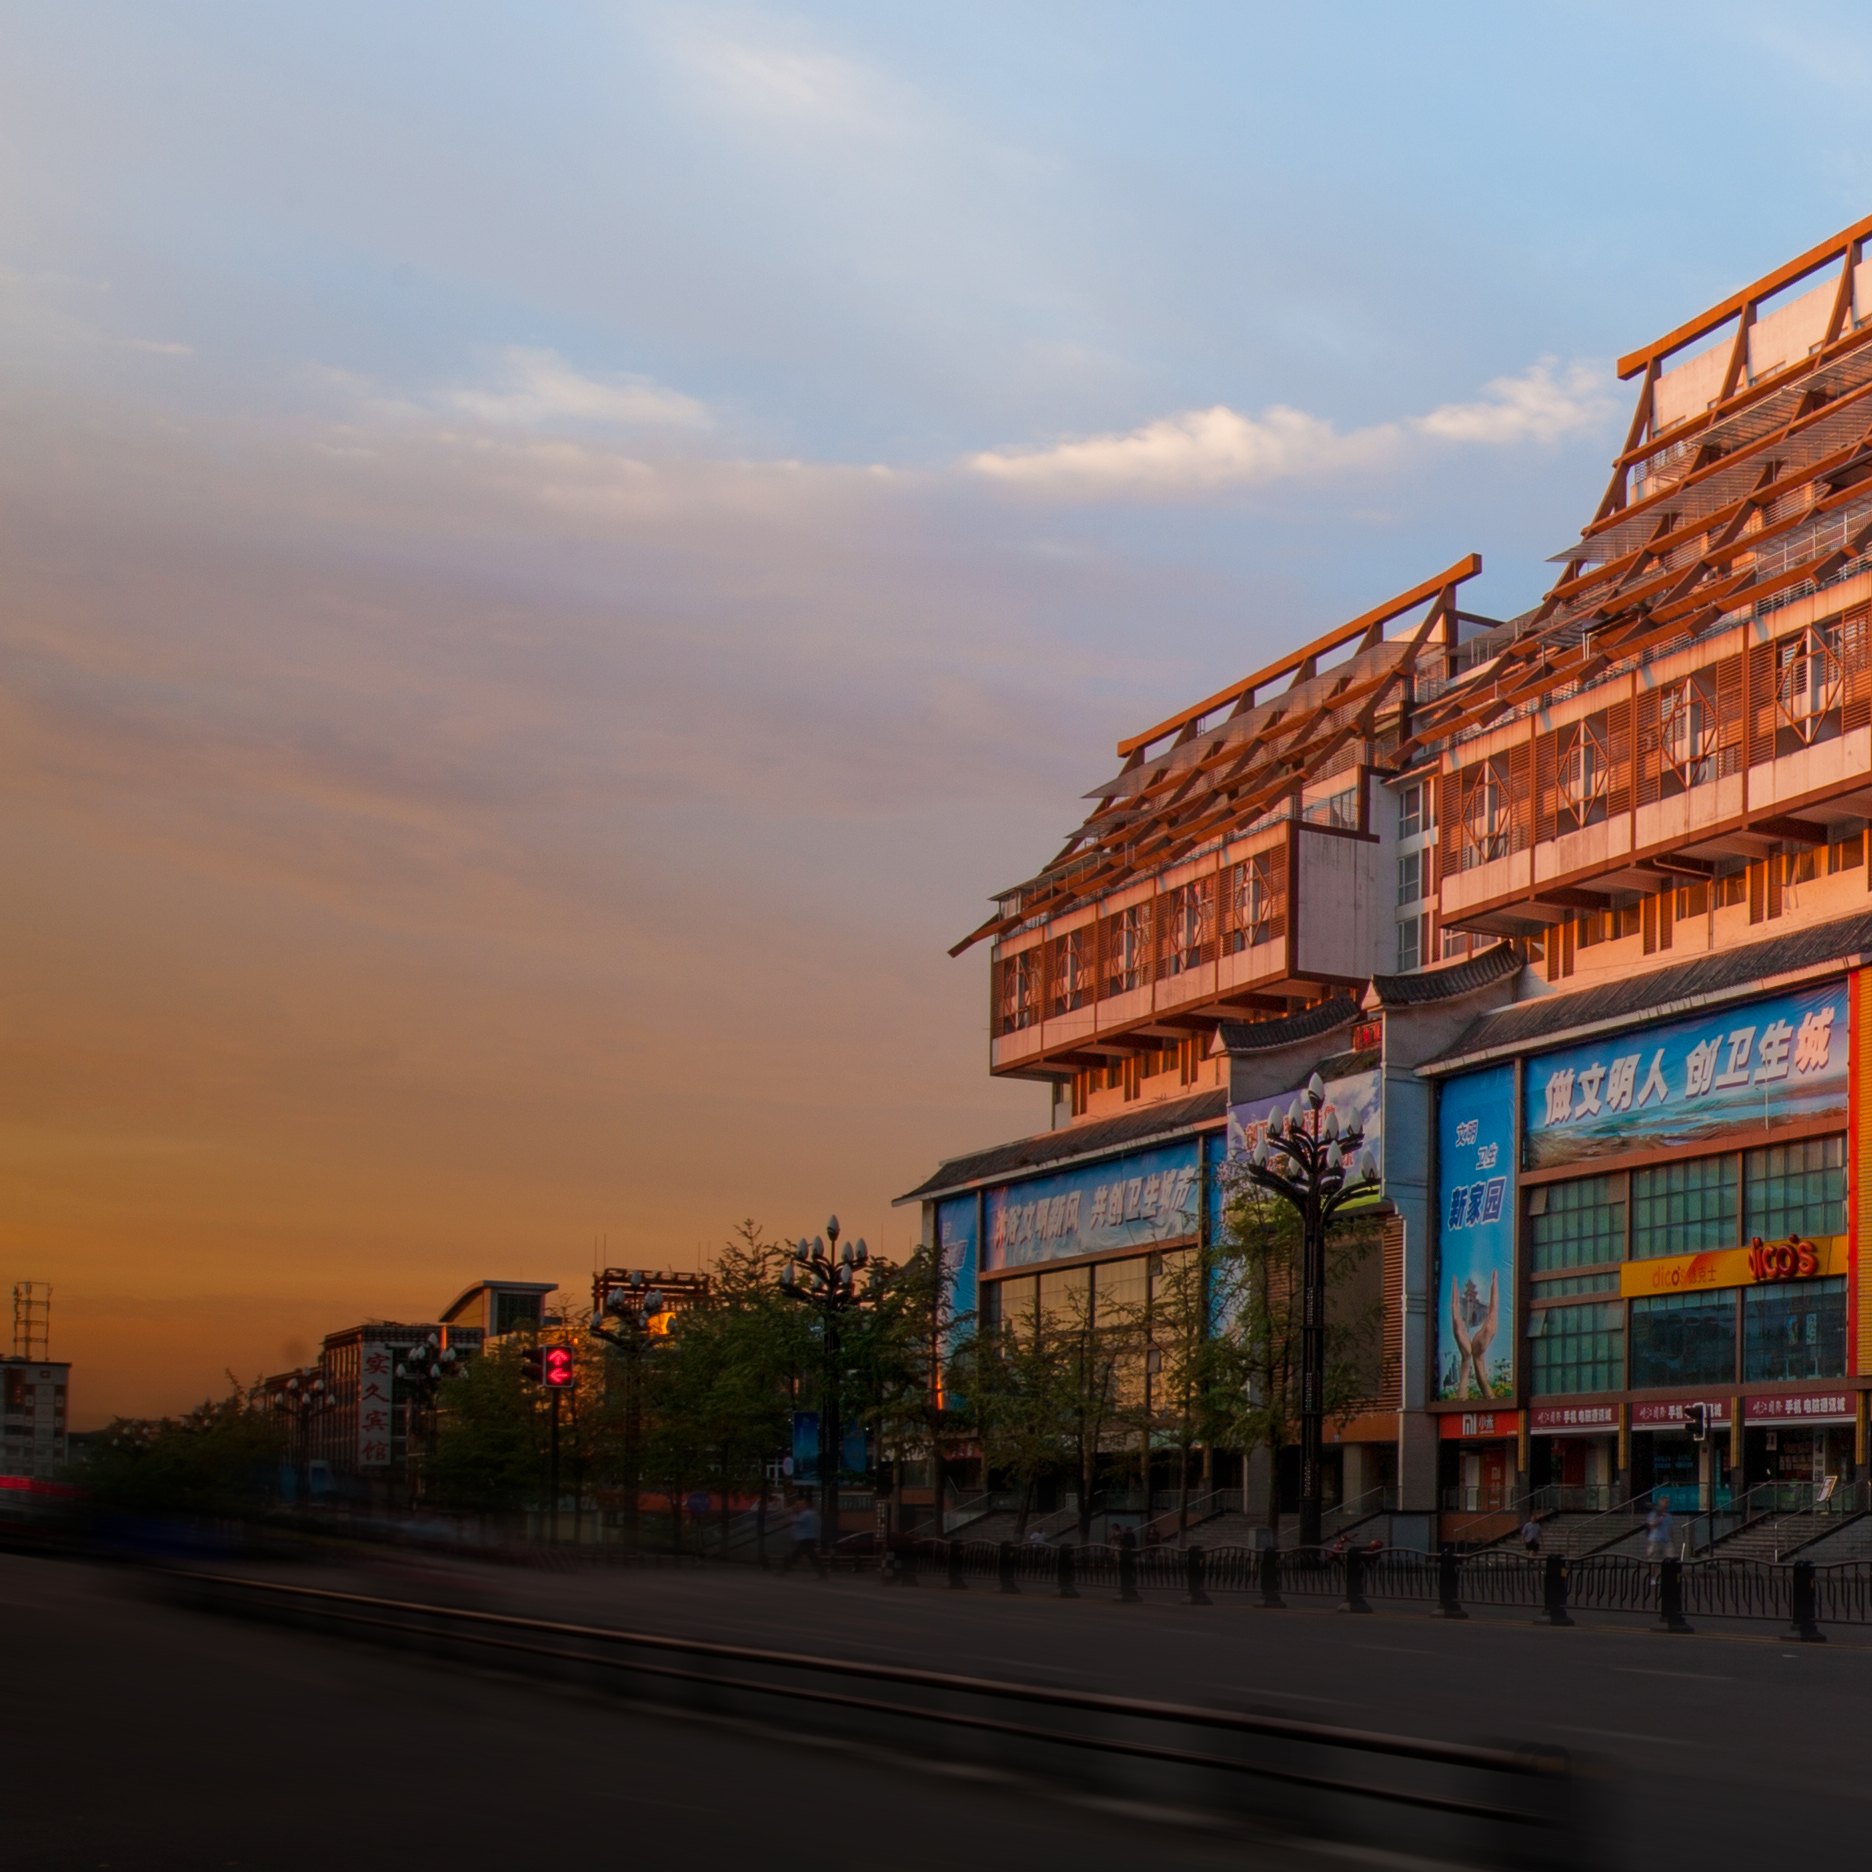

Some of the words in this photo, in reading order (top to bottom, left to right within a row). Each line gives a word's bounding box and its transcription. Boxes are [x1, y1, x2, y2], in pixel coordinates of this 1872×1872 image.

[1544, 1048, 1669, 1125] 做文明人
[1684, 1007, 1835, 1097] 创卫生城
[1455, 1119, 1478, 1146] 文明
[1476, 1142, 1498, 1169] 卫生
[1090, 1165, 1197, 1229] 共创卫生城市
[1449, 1177, 1505, 1230] 新家园
[1749, 1233, 1818, 1280] dico's
[363, 1352, 390, 1461] 实久宾馆
